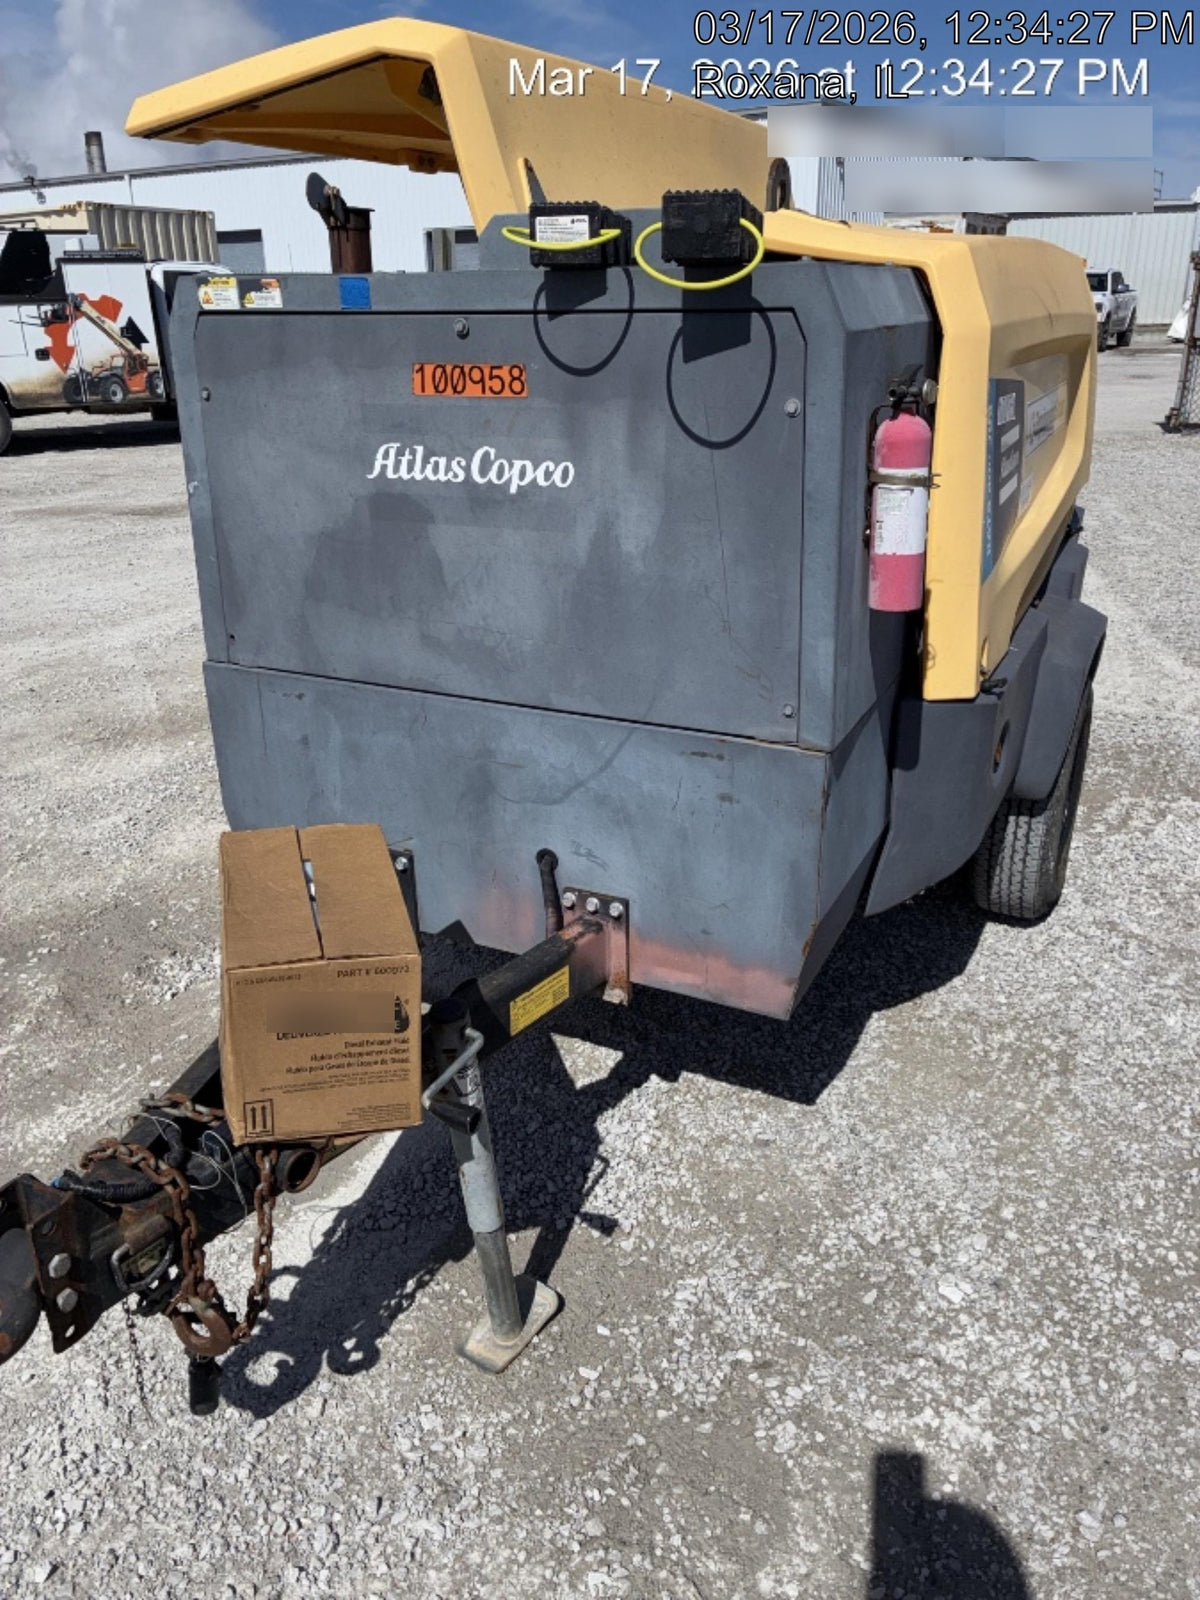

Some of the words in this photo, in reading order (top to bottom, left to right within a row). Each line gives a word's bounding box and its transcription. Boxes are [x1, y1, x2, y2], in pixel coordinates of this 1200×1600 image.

[415, 363, 525, 395] 100958
[366, 442, 466, 482] Atlas
[471, 446, 575, 494] Copco
